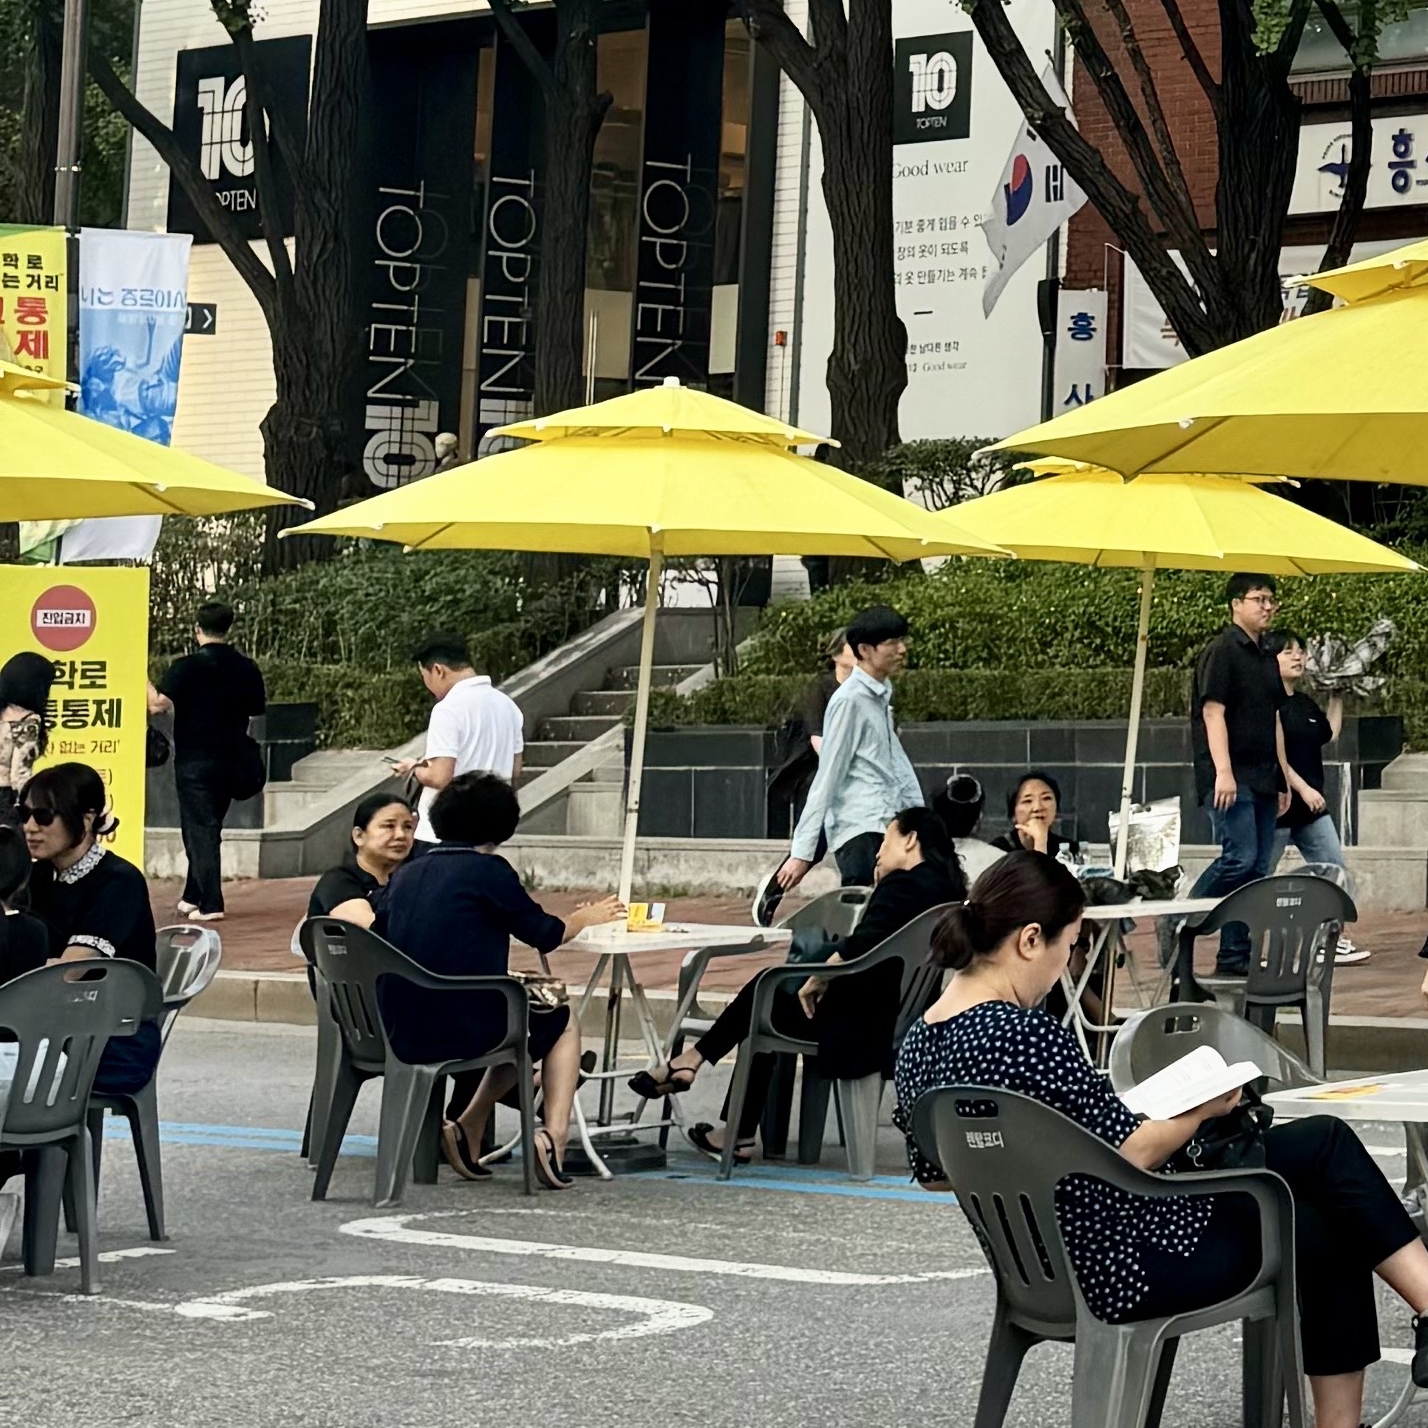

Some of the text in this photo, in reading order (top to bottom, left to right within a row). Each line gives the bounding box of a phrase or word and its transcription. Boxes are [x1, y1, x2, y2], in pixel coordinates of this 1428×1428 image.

[909, 51, 957, 112] 10
[934, 160, 968, 175] wear
[961, 215, 970, 228] 수
[2, 253, 43, 270] 학로
[633, 152, 694, 382] TOPTEN
[366, 179, 426, 400] TOPTEN
[480, 168, 536, 393] TOPTEN
[14, 330, 49, 360] 제
[1058, 311, 1098, 406] 흥사
[42, 612, 86, 625] 진입금지
[51, 660, 107, 690] 학로
